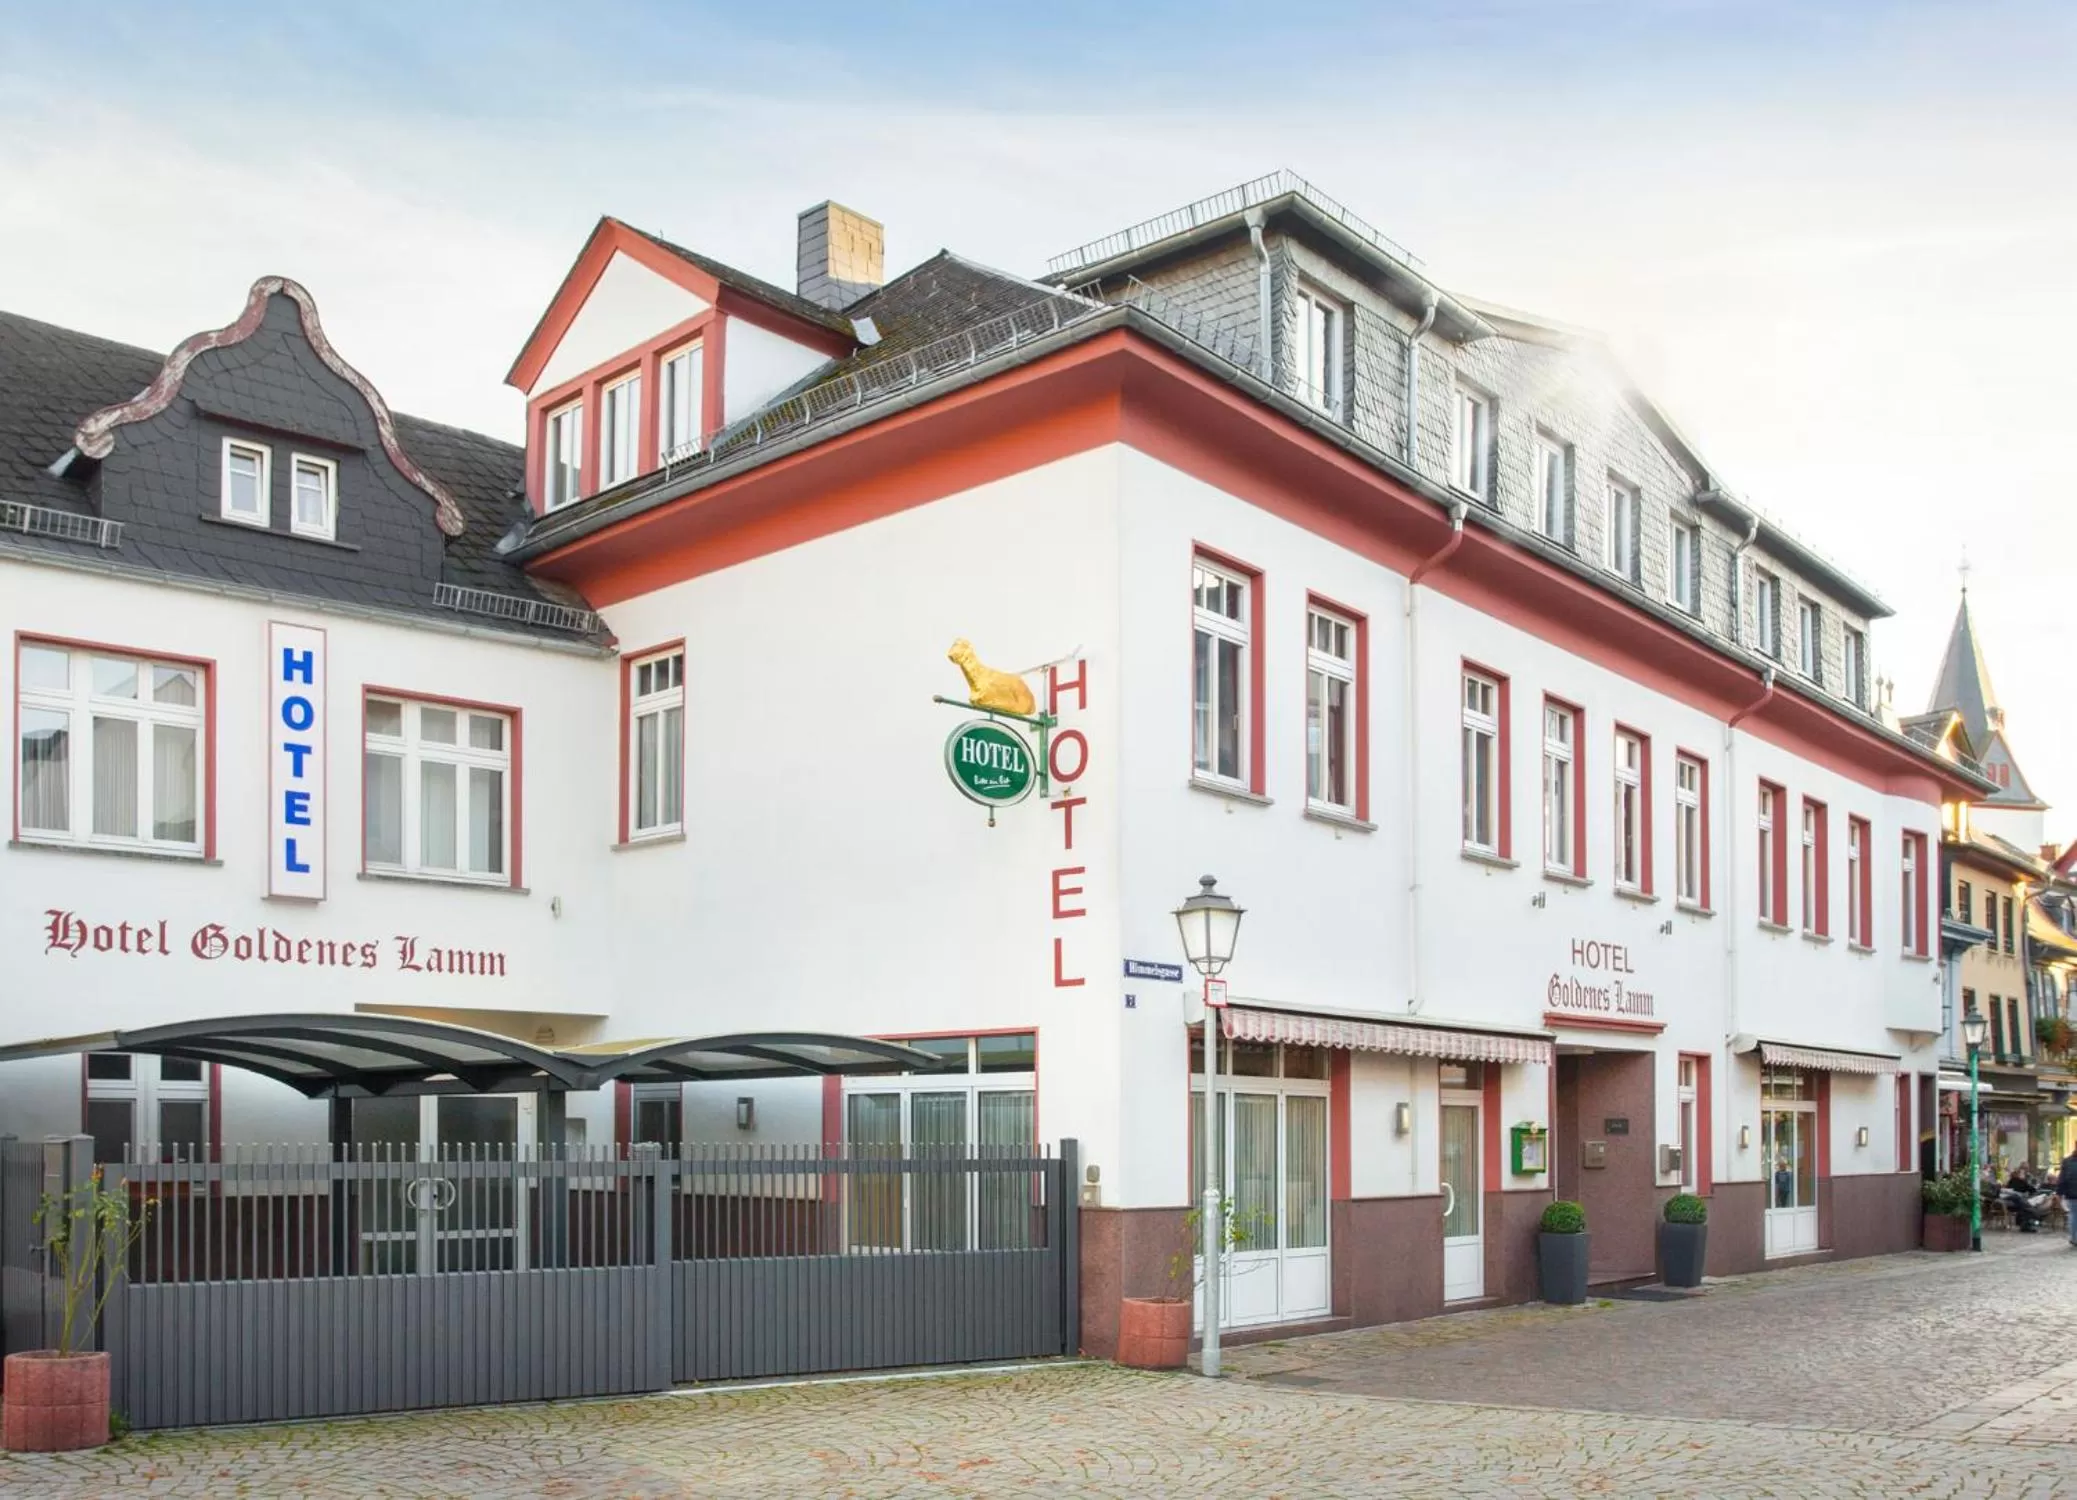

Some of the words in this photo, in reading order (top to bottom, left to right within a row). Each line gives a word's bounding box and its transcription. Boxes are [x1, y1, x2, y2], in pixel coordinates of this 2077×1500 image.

[281, 647, 315, 875] HOTEL
[961, 736, 1025, 774] HOTEL
[1048, 659, 1089, 988] HOTEL
[44, 908, 171, 959] Hotel
[190, 922, 379, 969] Goldenes
[394, 934, 508, 978] Lamm
[1571, 937, 1635, 974] HOTEL
[1547, 972, 1611, 1012] Goldenes
[1613, 978, 1655, 1018] Lamm
